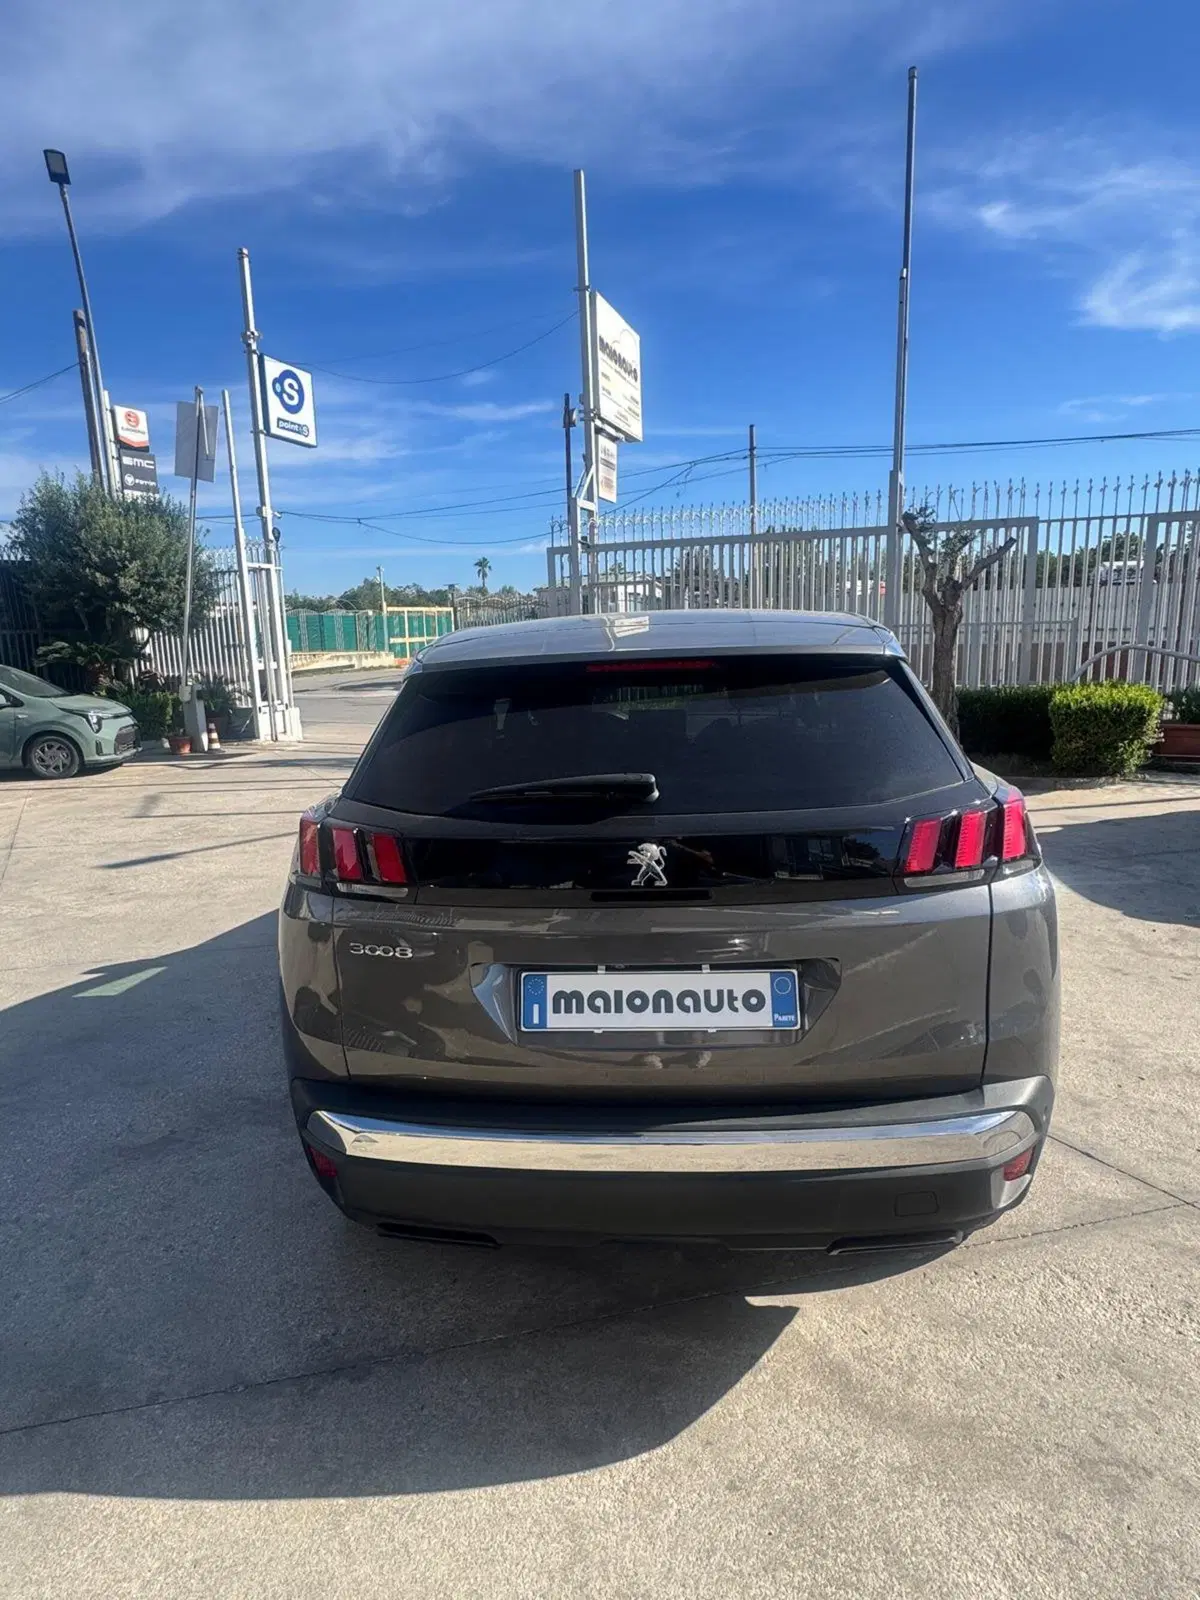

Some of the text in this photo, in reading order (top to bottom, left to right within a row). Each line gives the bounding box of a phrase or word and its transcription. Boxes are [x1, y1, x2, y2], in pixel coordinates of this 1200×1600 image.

[282, 378, 299, 406] S
[279, 420, 299, 431] point
[350, 942, 413, 958] 3008
